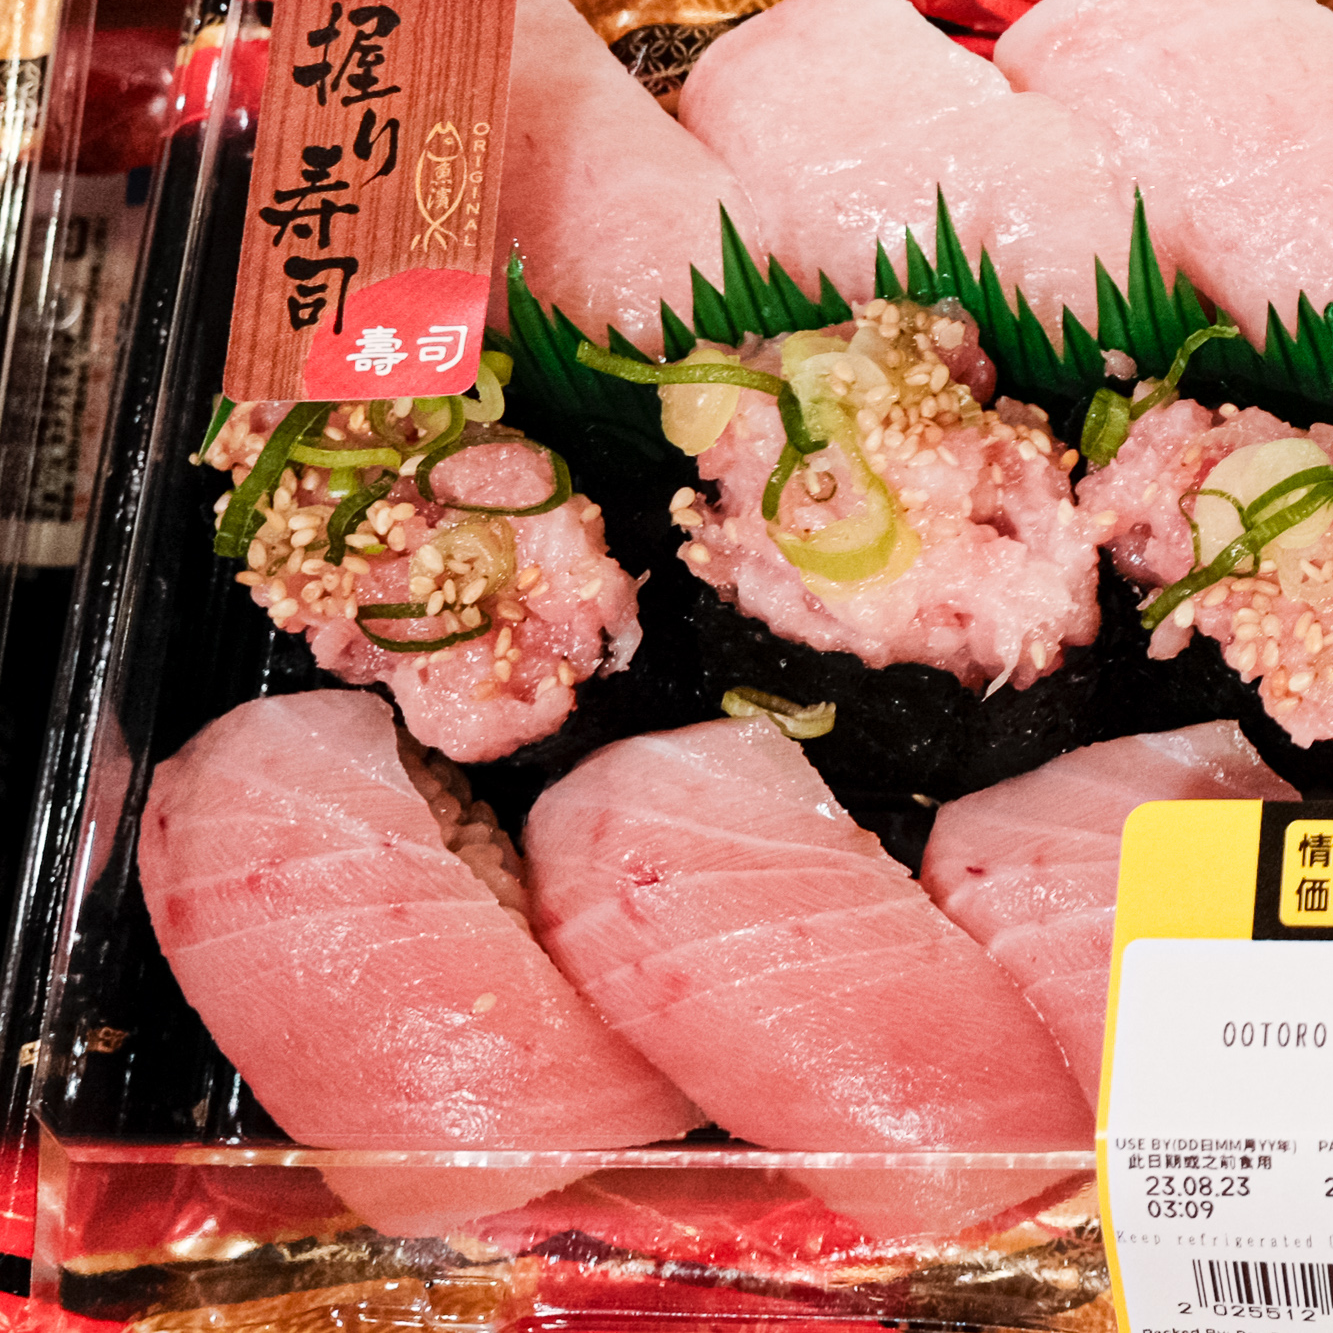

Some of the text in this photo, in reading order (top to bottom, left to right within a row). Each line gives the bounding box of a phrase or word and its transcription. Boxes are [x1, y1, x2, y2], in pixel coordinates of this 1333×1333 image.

[259, 1, 401, 335] 握り寿司
[463, 121, 490, 247] ORIGINAL
[346, 325, 469, 376] 壽司
[1222, 1021, 1327, 1049] OOTORO
[1115, 1137, 1145, 1151] USE
[1145, 1175, 1251, 1197] 23.08.23
[1147, 1199, 1214, 1219] 03:09
[1177, 1231, 1313, 1249] refrigerated
[1178, 1301, 1194, 1315] 2
[1213, 1302, 1316, 1322] 025512
